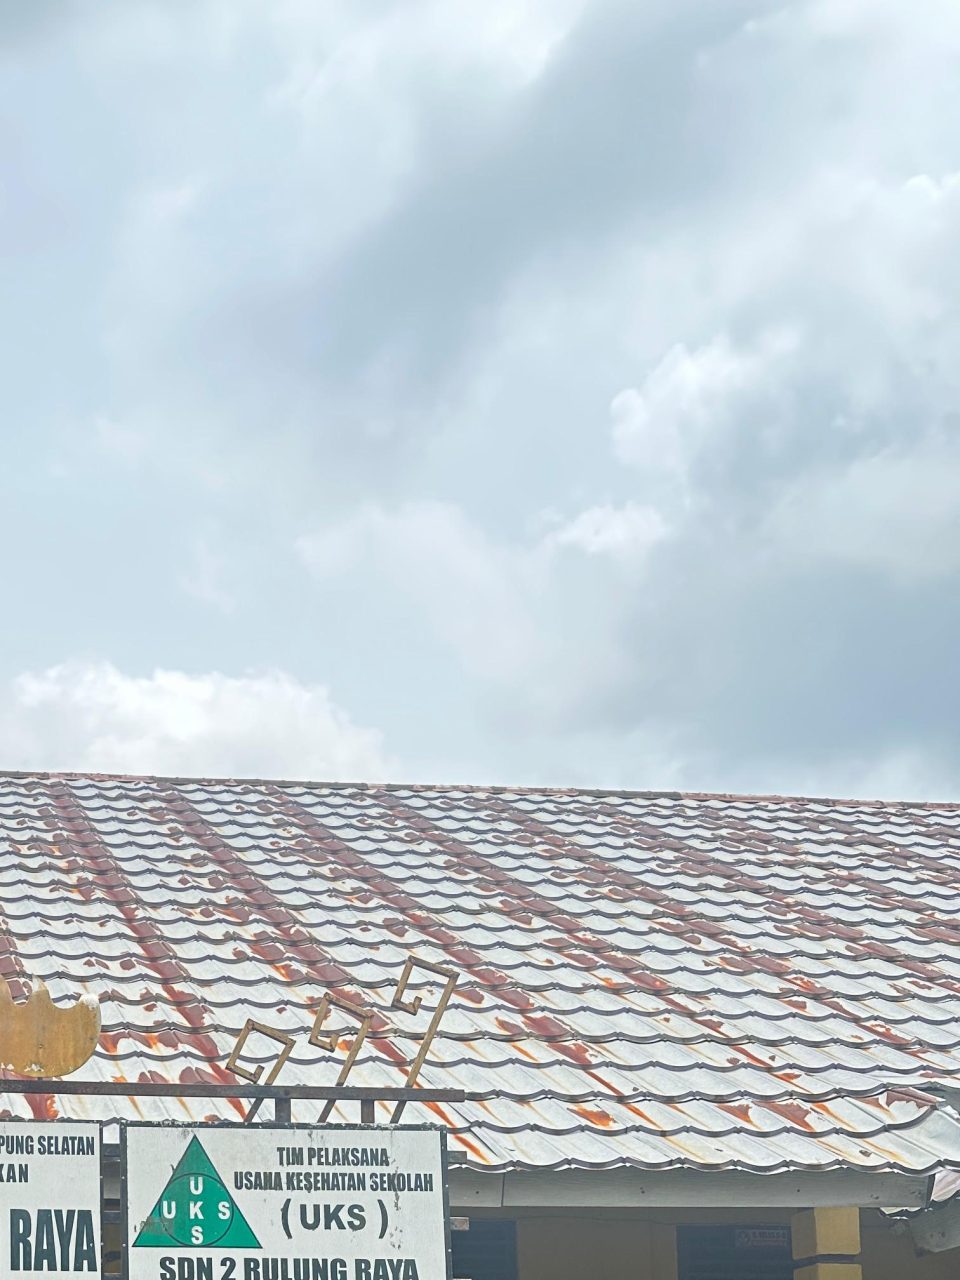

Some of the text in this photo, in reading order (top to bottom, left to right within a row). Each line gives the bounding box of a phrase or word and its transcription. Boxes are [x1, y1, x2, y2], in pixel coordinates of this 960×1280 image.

[38, 1136, 94, 1155] SELATAN
[277, 1147, 389, 1166] TIM PELAKSANA
[234, 1172, 433, 1193] USAHA KESEHATAN SEKOLAH
[10, 1208, 98, 1272] RAYA
